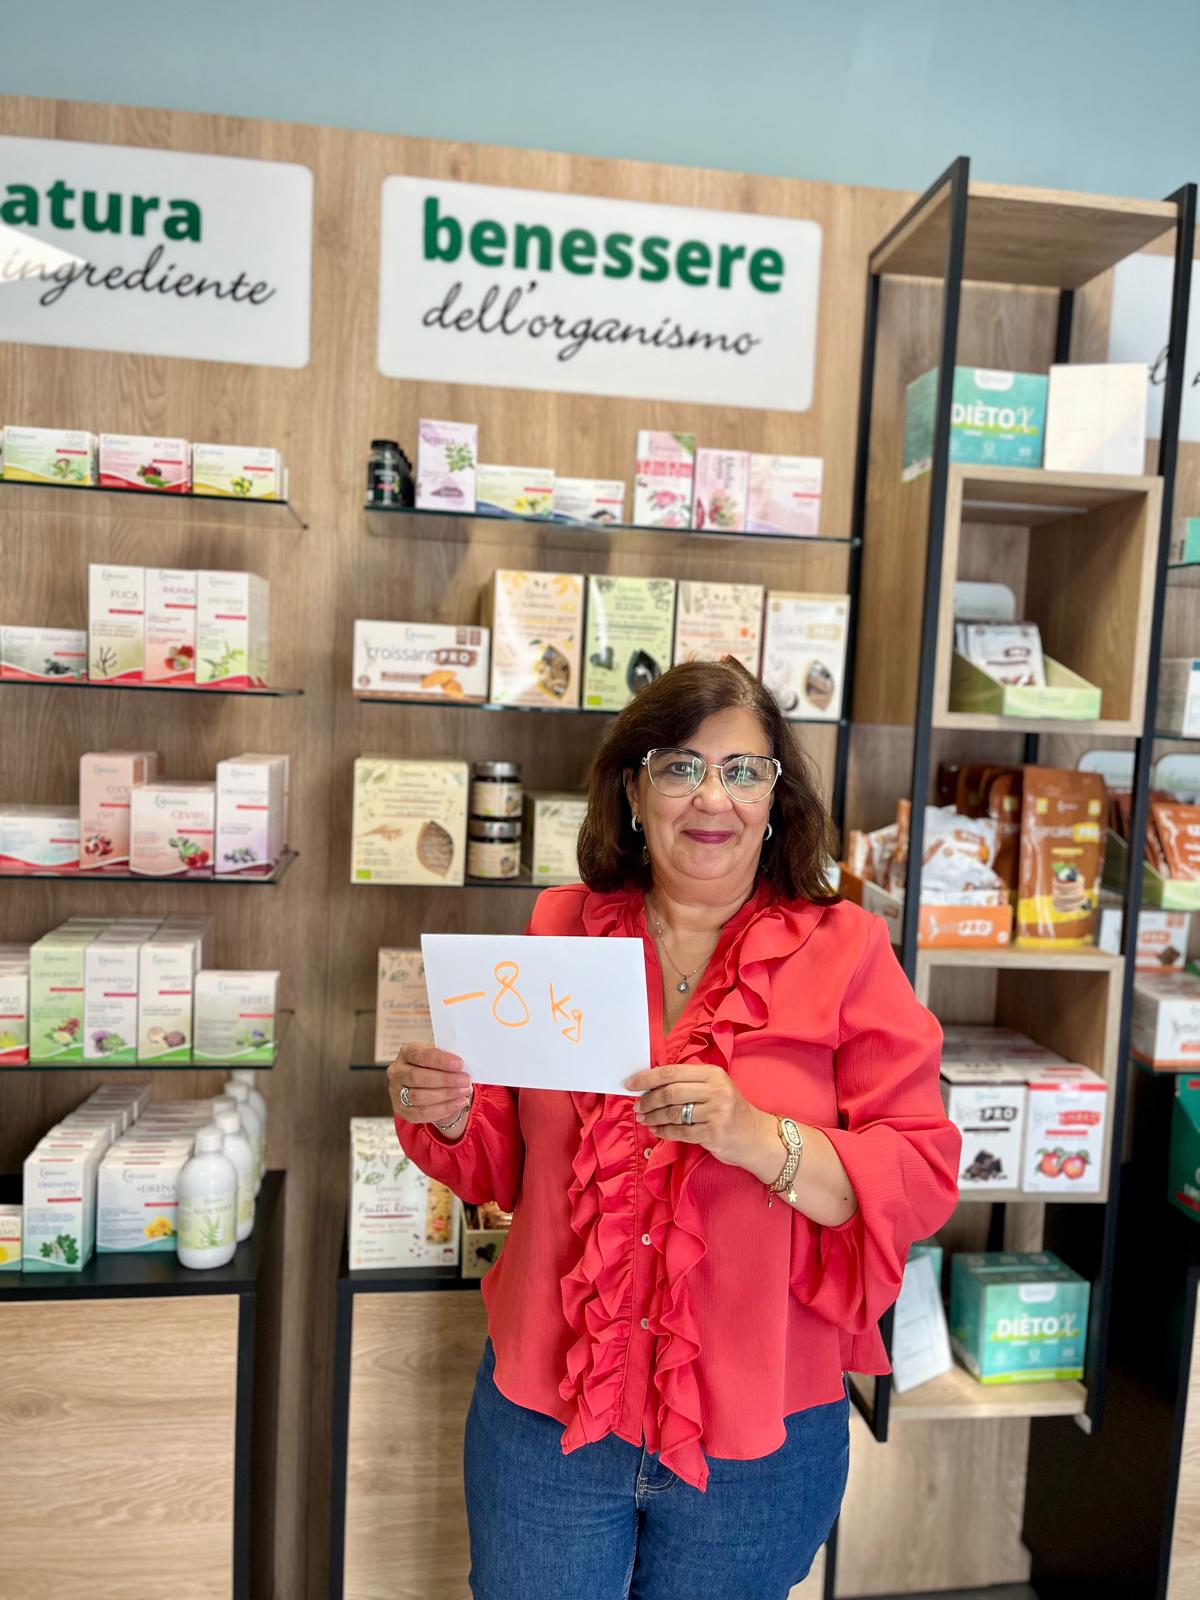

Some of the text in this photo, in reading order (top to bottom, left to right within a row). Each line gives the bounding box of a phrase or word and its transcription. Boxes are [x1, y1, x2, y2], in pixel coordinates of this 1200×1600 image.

[2, 244, 277, 307] ingrediente
[423, 196, 786, 294] benessere
[422, 281, 762, 362] dell'organismo
